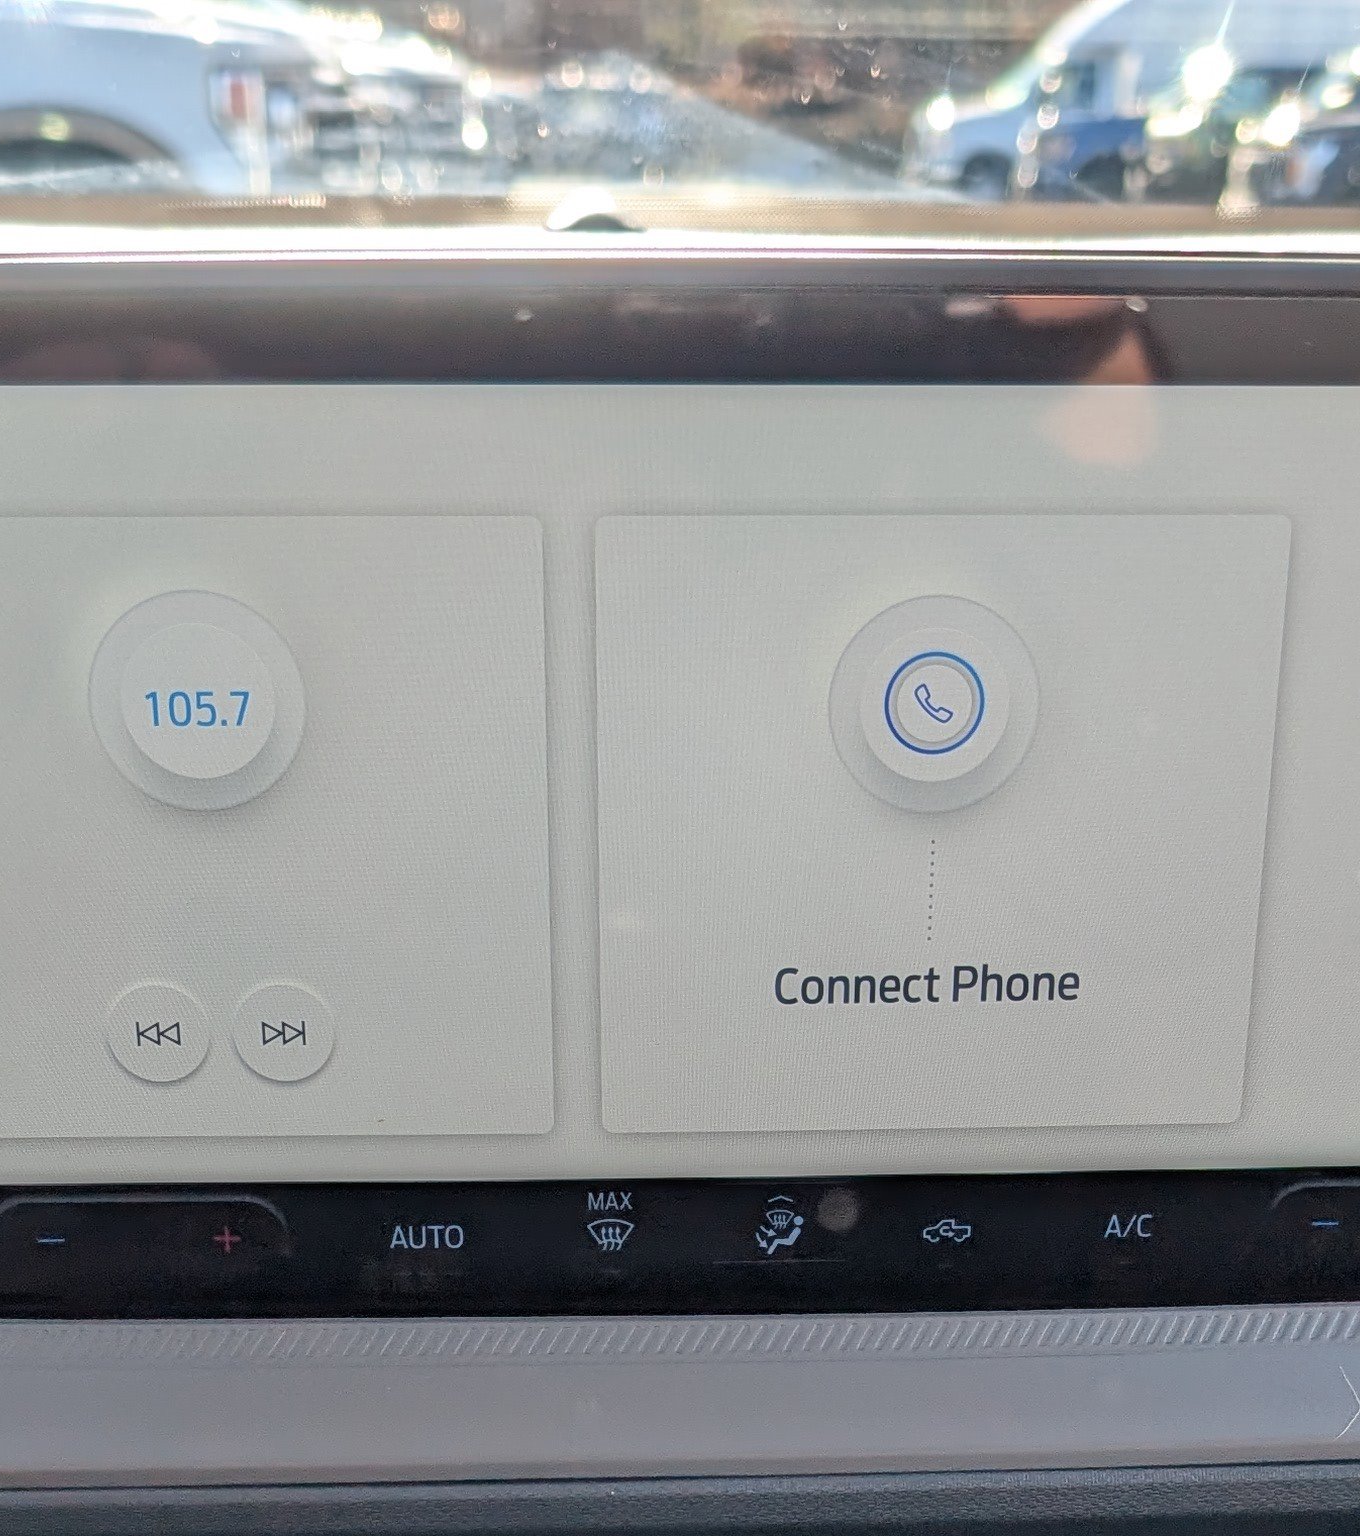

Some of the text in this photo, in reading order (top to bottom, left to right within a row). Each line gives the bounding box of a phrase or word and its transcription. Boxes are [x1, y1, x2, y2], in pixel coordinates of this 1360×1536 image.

[143, 689, 252, 729] 105.7
[774, 964, 1080, 1004] Connect Phone
[587, 1192, 634, 1211] MAX
[389, 1225, 465, 1250] AUTO
[1104, 1211, 1153, 1239] A/C
